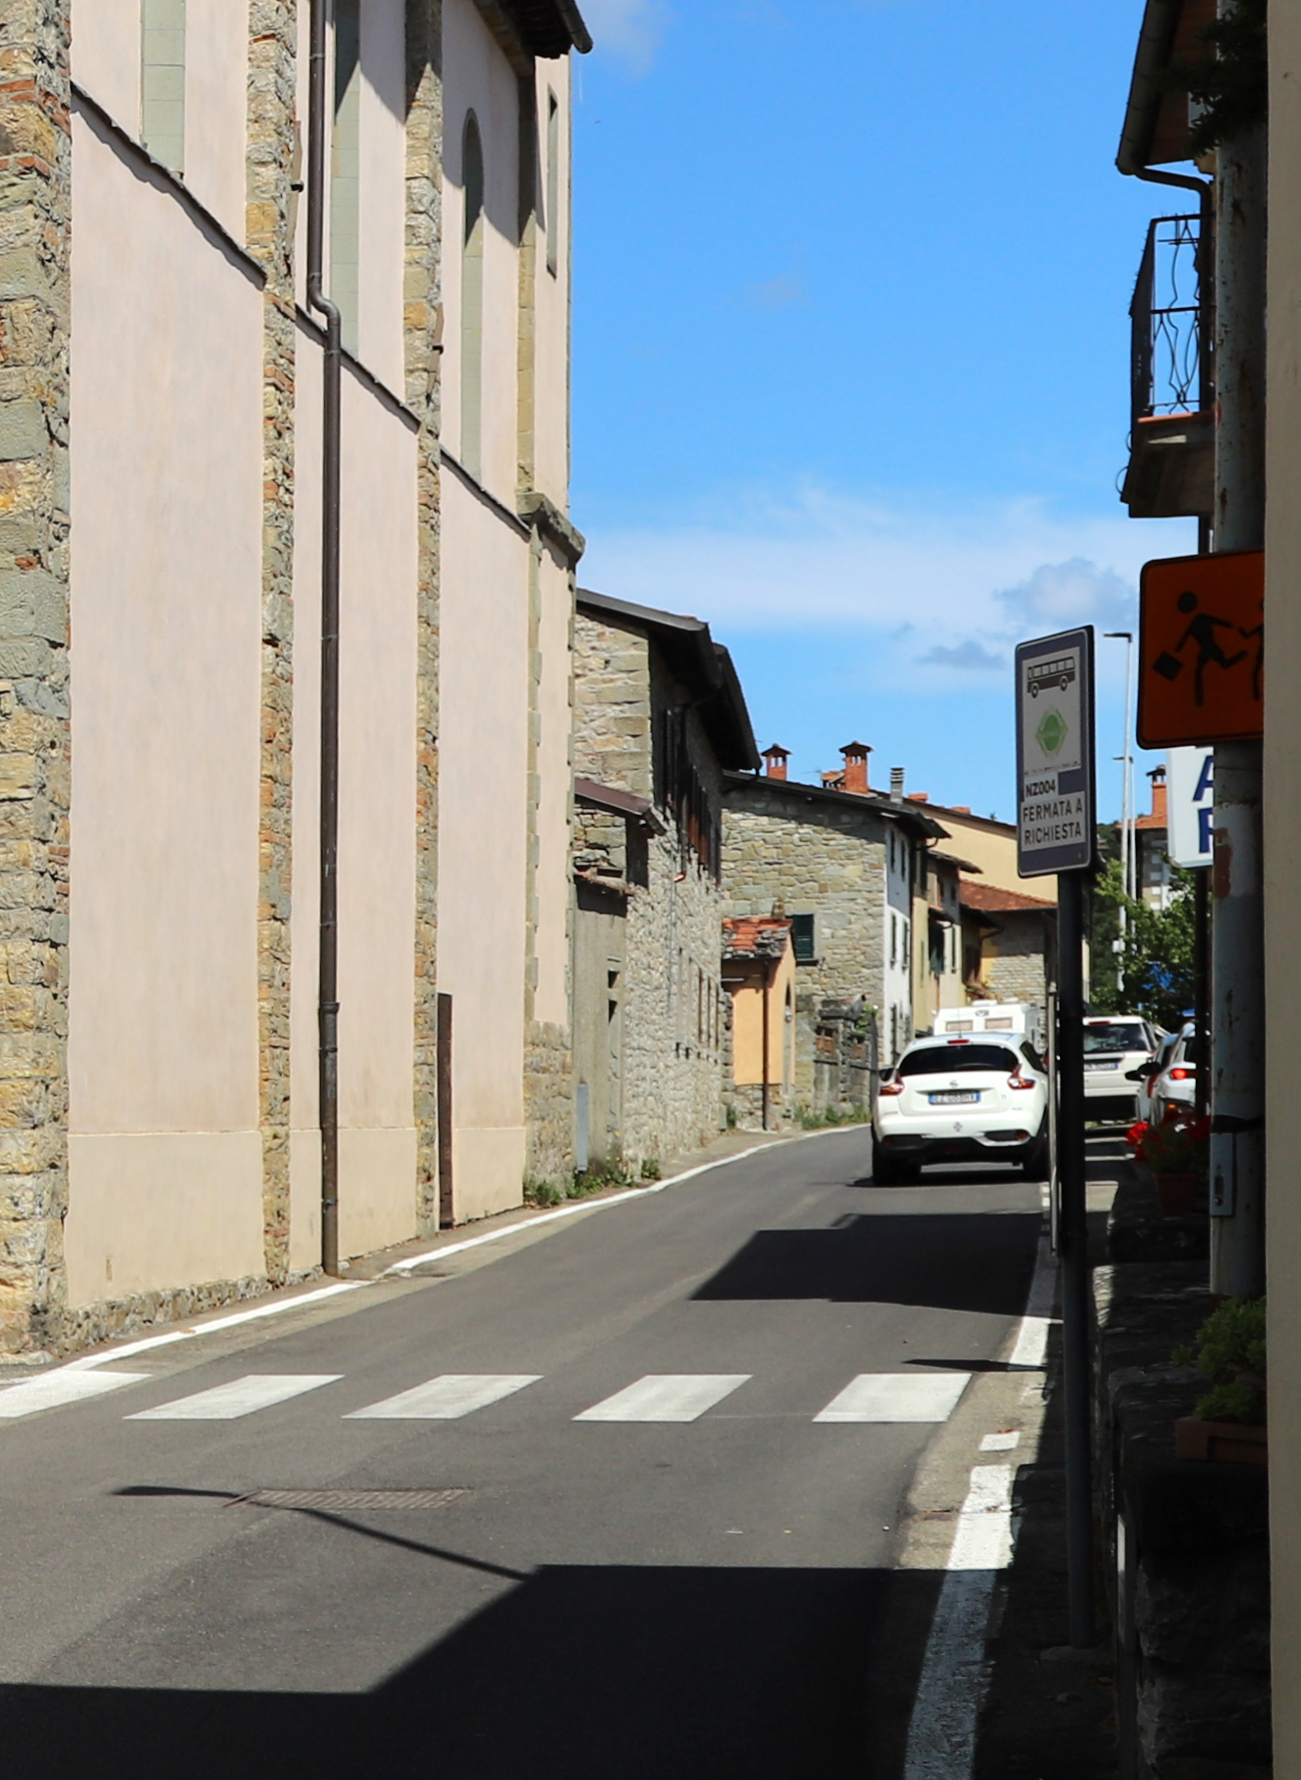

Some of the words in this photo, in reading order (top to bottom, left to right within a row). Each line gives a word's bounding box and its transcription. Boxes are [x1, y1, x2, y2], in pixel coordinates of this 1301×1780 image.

[1025, 779, 1056, 798] NZ004
[1023, 800, 1072, 823] FERMATA
[1076, 797, 1083, 814] A
[1024, 821, 1082, 845] RICHIESTA
